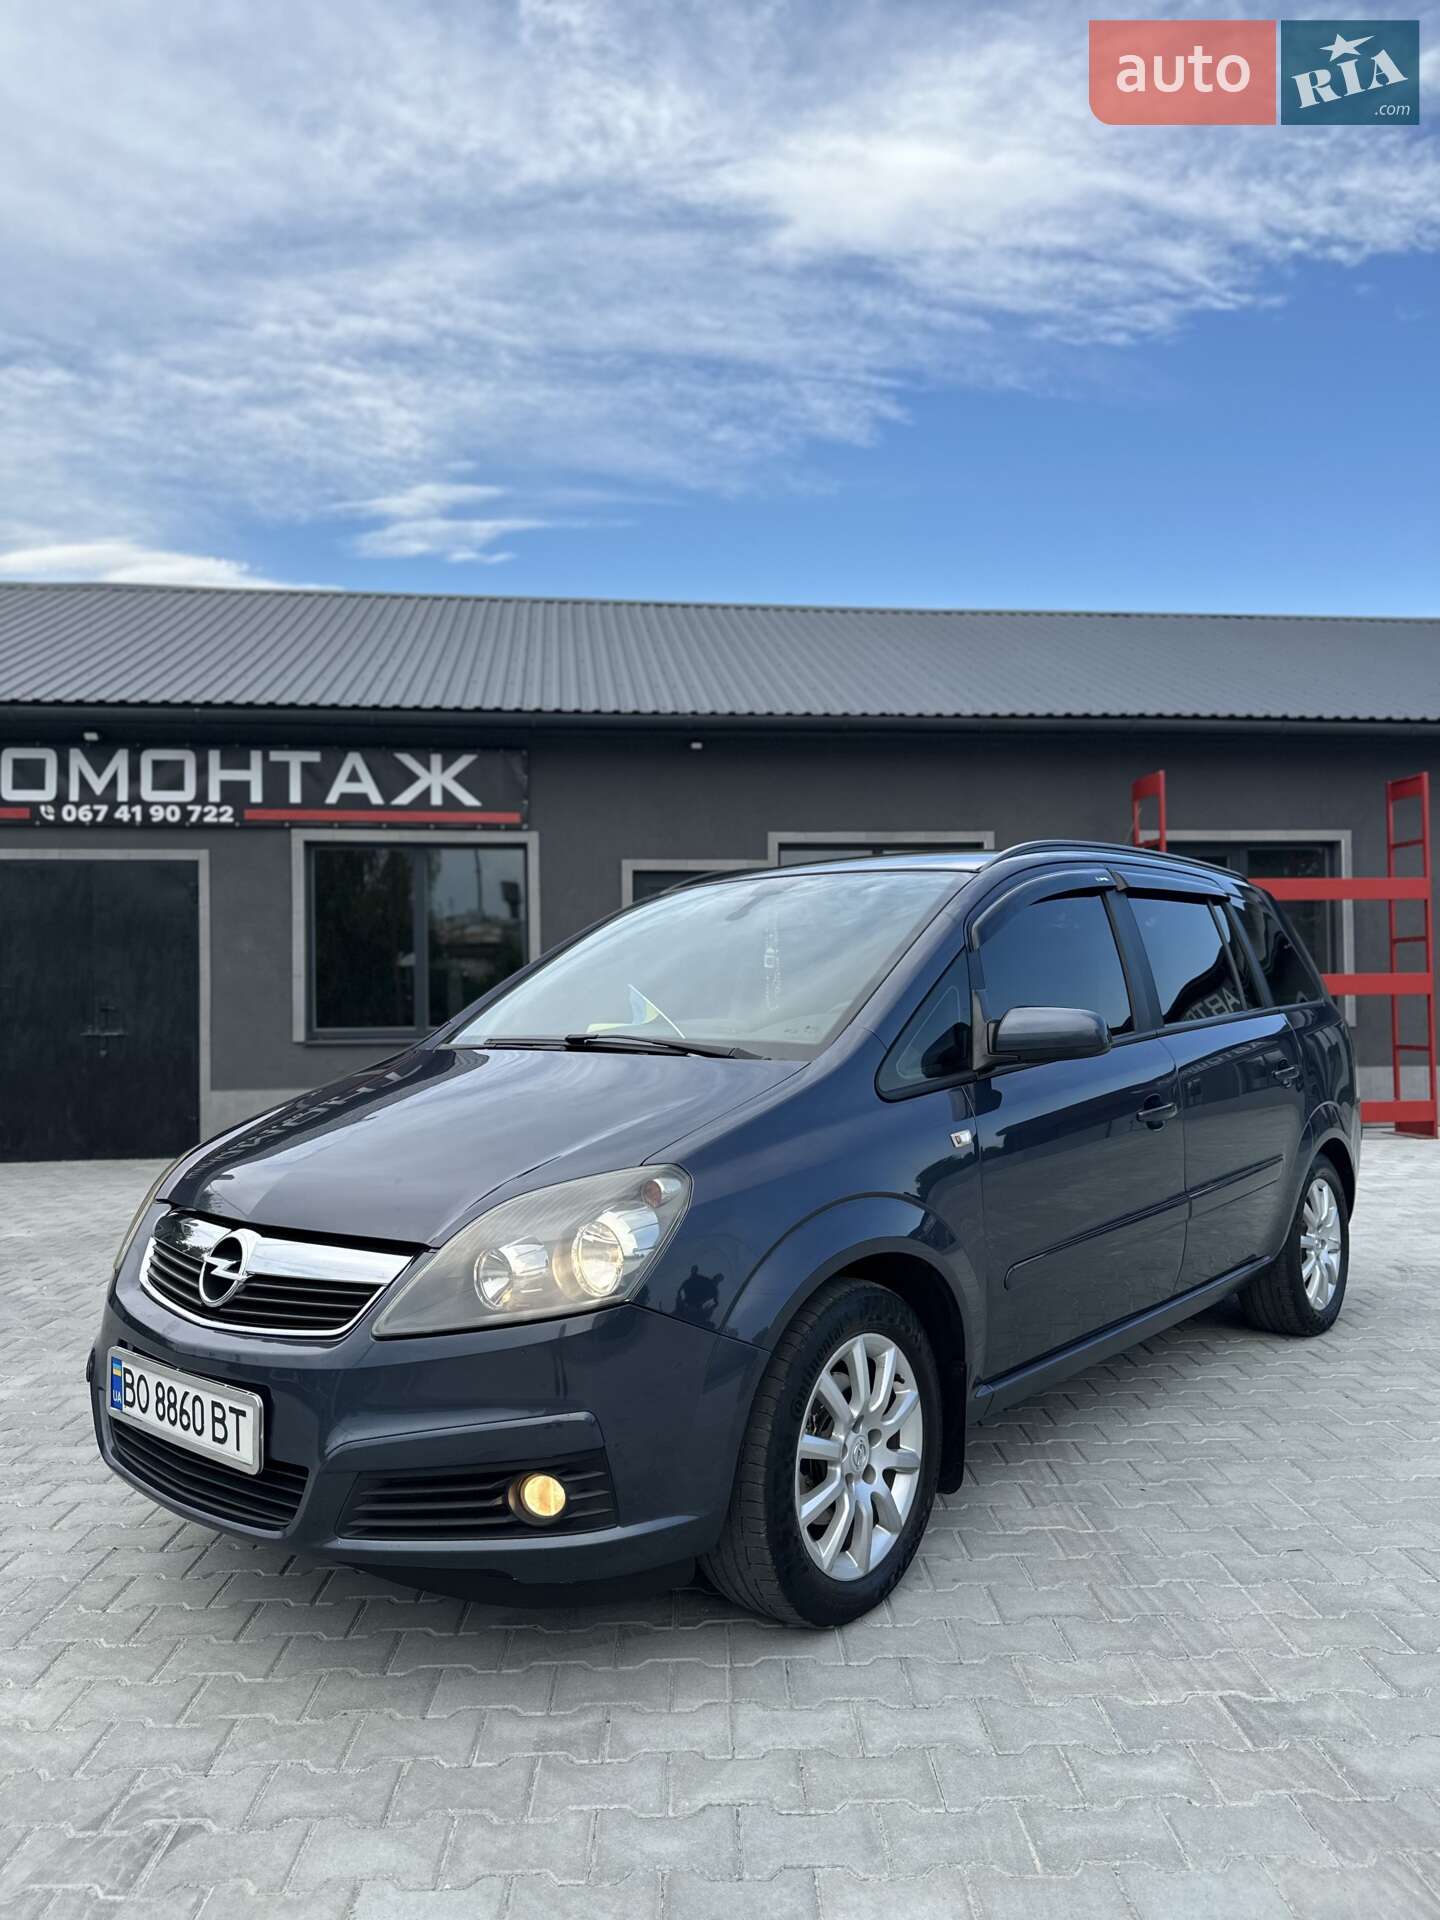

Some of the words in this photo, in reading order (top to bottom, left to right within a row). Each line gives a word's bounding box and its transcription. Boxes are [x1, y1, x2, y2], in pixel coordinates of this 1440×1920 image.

[61, 804, 109, 823] 067
[113, 804, 143, 823] 41
[149, 804, 181, 823] 90
[186, 804, 235, 824] 722
[112, 1391, 122, 1403] UA
[122, 1366, 150, 1415] BO
[154, 1381, 205, 1437] 8860
[211, 1400, 247, 1452] BT
